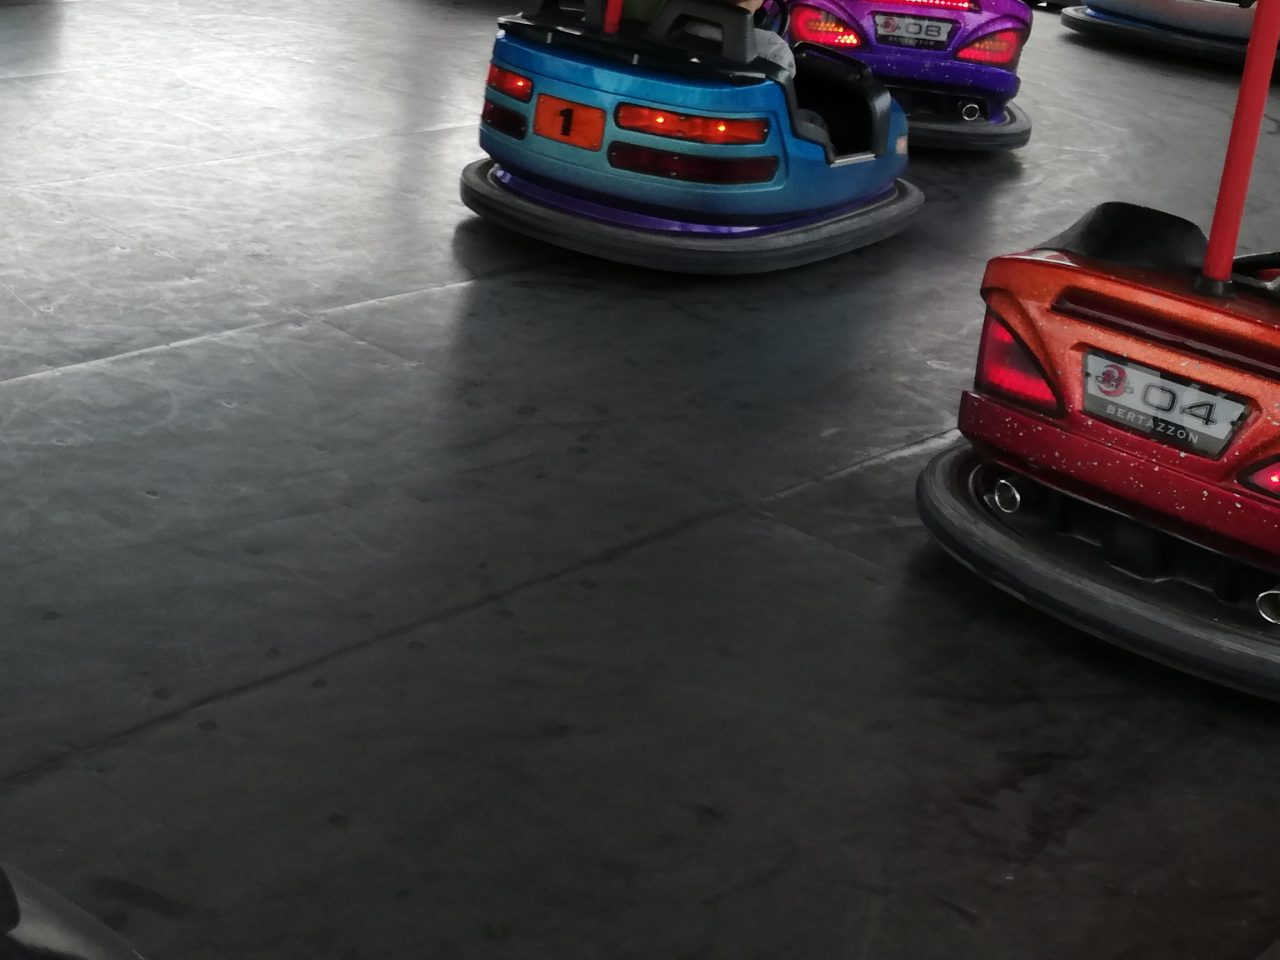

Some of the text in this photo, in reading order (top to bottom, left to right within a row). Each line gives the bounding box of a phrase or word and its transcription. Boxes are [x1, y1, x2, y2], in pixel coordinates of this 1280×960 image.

[559, 107, 574, 137] 1
[1106, 403, 1200, 445] BERTAZZON
[1141, 382, 1218, 427] 04
